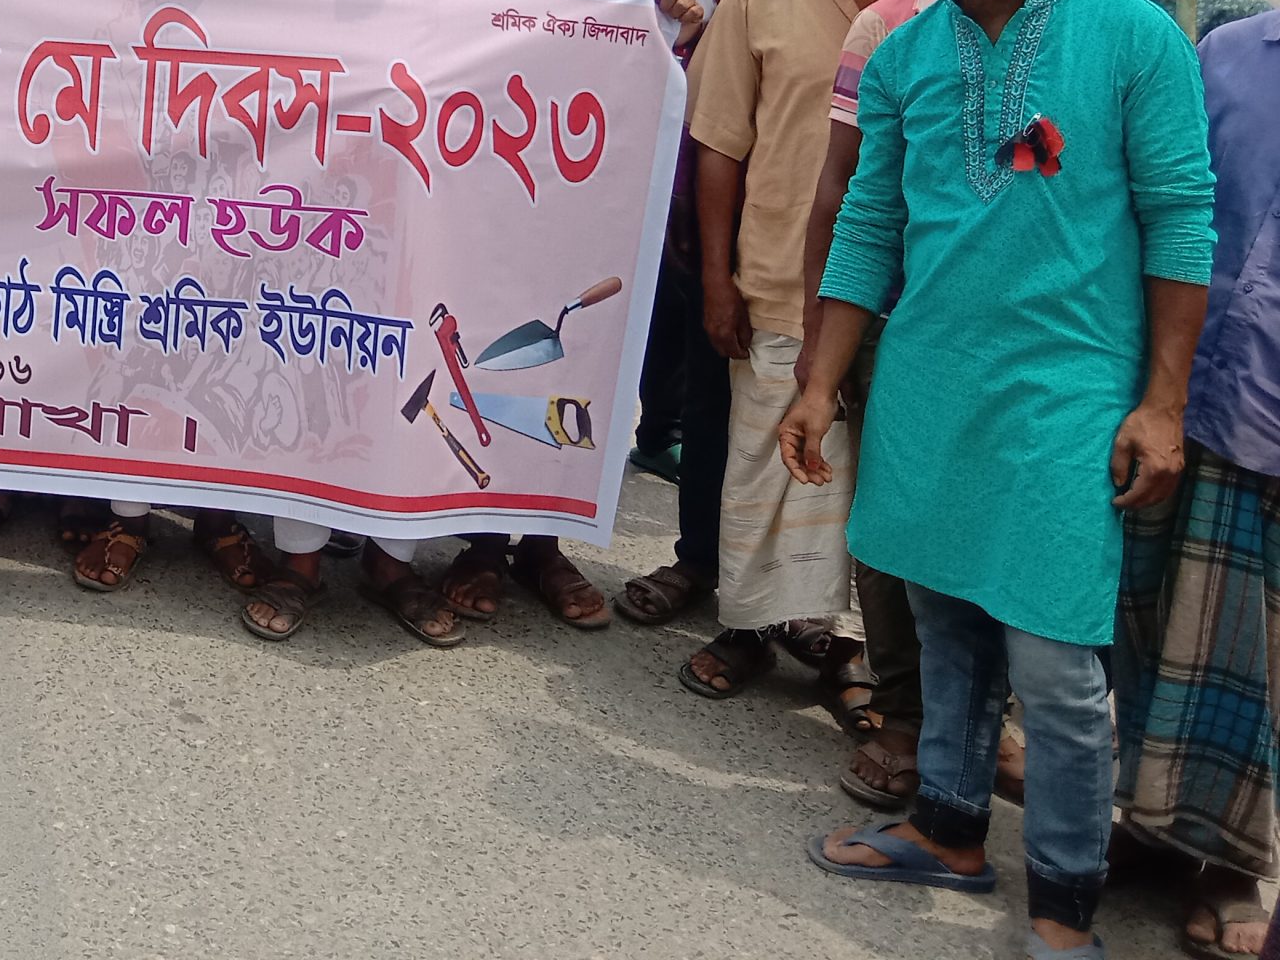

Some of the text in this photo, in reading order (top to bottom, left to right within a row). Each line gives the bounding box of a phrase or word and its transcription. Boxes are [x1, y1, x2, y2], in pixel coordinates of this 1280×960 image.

[491, 10, 649, 47] শ্রমিক ঐক্য জিন্দাবাদ
[19, 40, 117, 151] মে
[35, 176, 368, 258] সফল হউক
[51, 266, 130, 351] মিস্ত্রি
[138, 278, 247, 354] শ্রমিক
[257, 284, 414, 378] ইউনিয়ন
